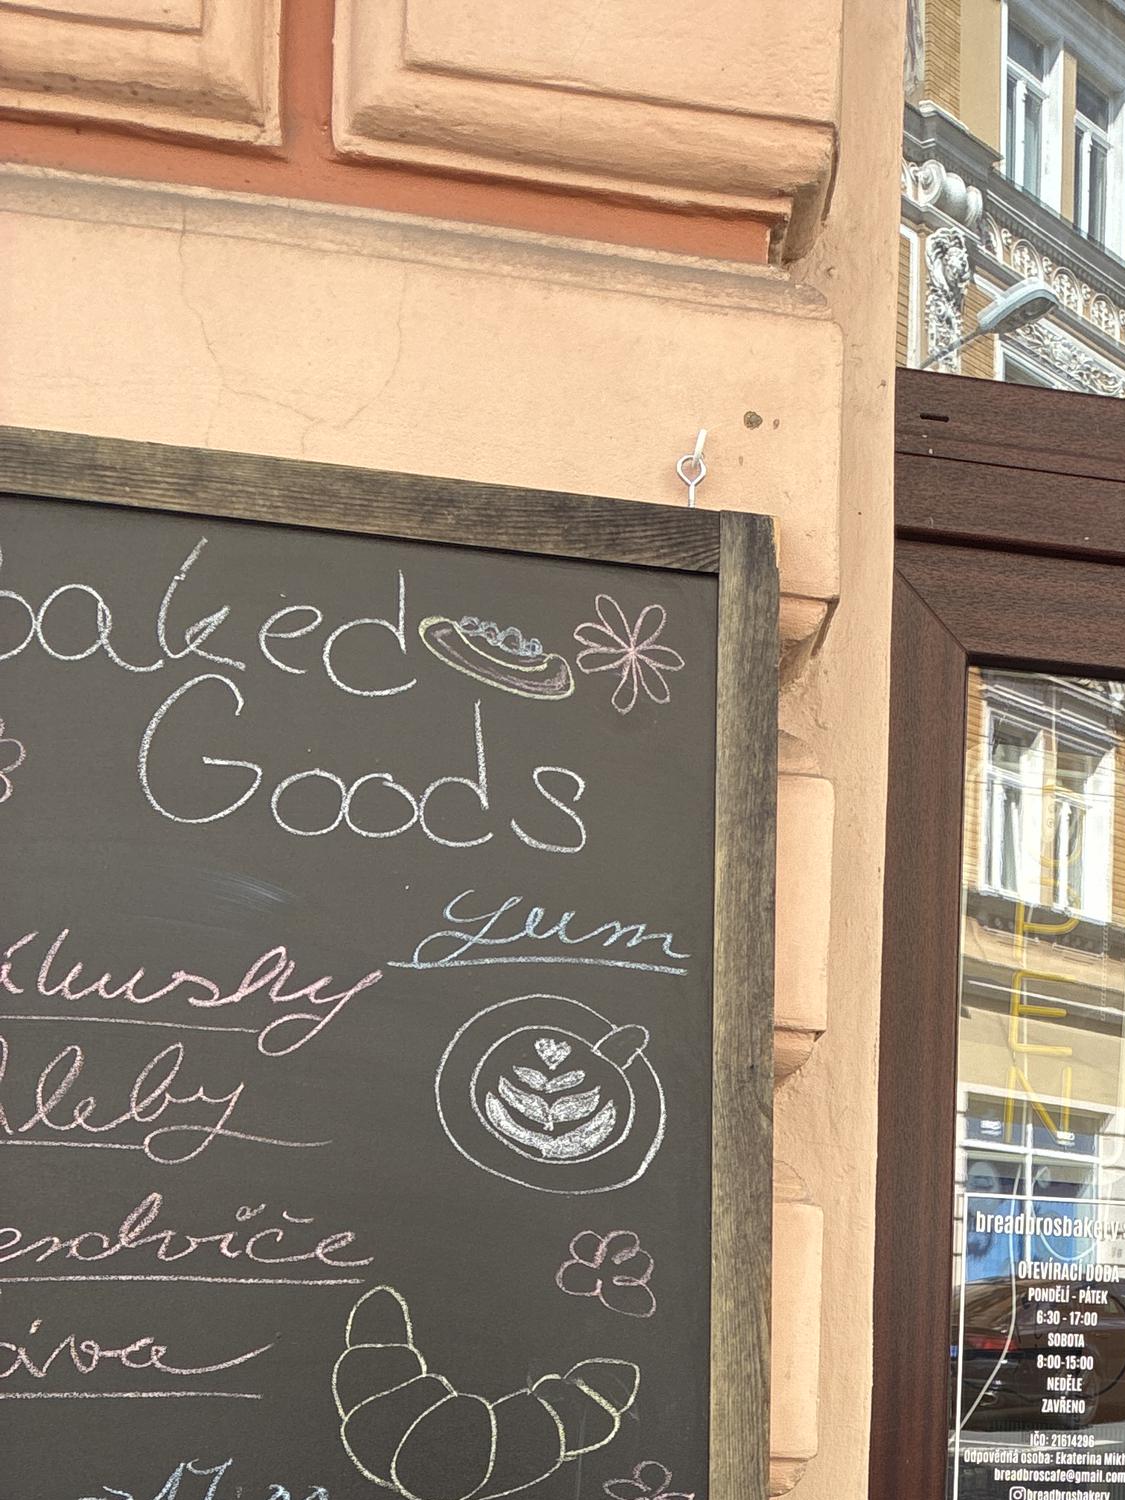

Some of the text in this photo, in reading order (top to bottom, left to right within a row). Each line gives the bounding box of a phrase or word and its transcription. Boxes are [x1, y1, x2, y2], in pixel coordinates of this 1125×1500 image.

[138, 673, 587, 853] Goods
[0, 1036, 333, 1165] leby
[1018, 1258, 1120, 1283] OTEVÍRACÍ DOBA
[1028, 1285, 1070, 1302] PONDĚLÍ
[1079, 1287, 1108, 1305] PÁTEK
[1036, 1310, 1061, 1325] 6:30
[1069, 1311, 1098, 1326] 17:00
[1047, 1332, 1086, 1348] SOBOTA
[1036, 1354, 1094, 1370] 8:00-15:00
[1046, 1374, 1083, 1392] NEDĚLE
[1041, 1396, 1086, 1414] ZAVŘENO
[963, 1449, 1018, 1465] Odpovědná
[1020, 1452, 1054, 1465] osoba:
[1055, 1452, 1101, 1466] Ekaterina
